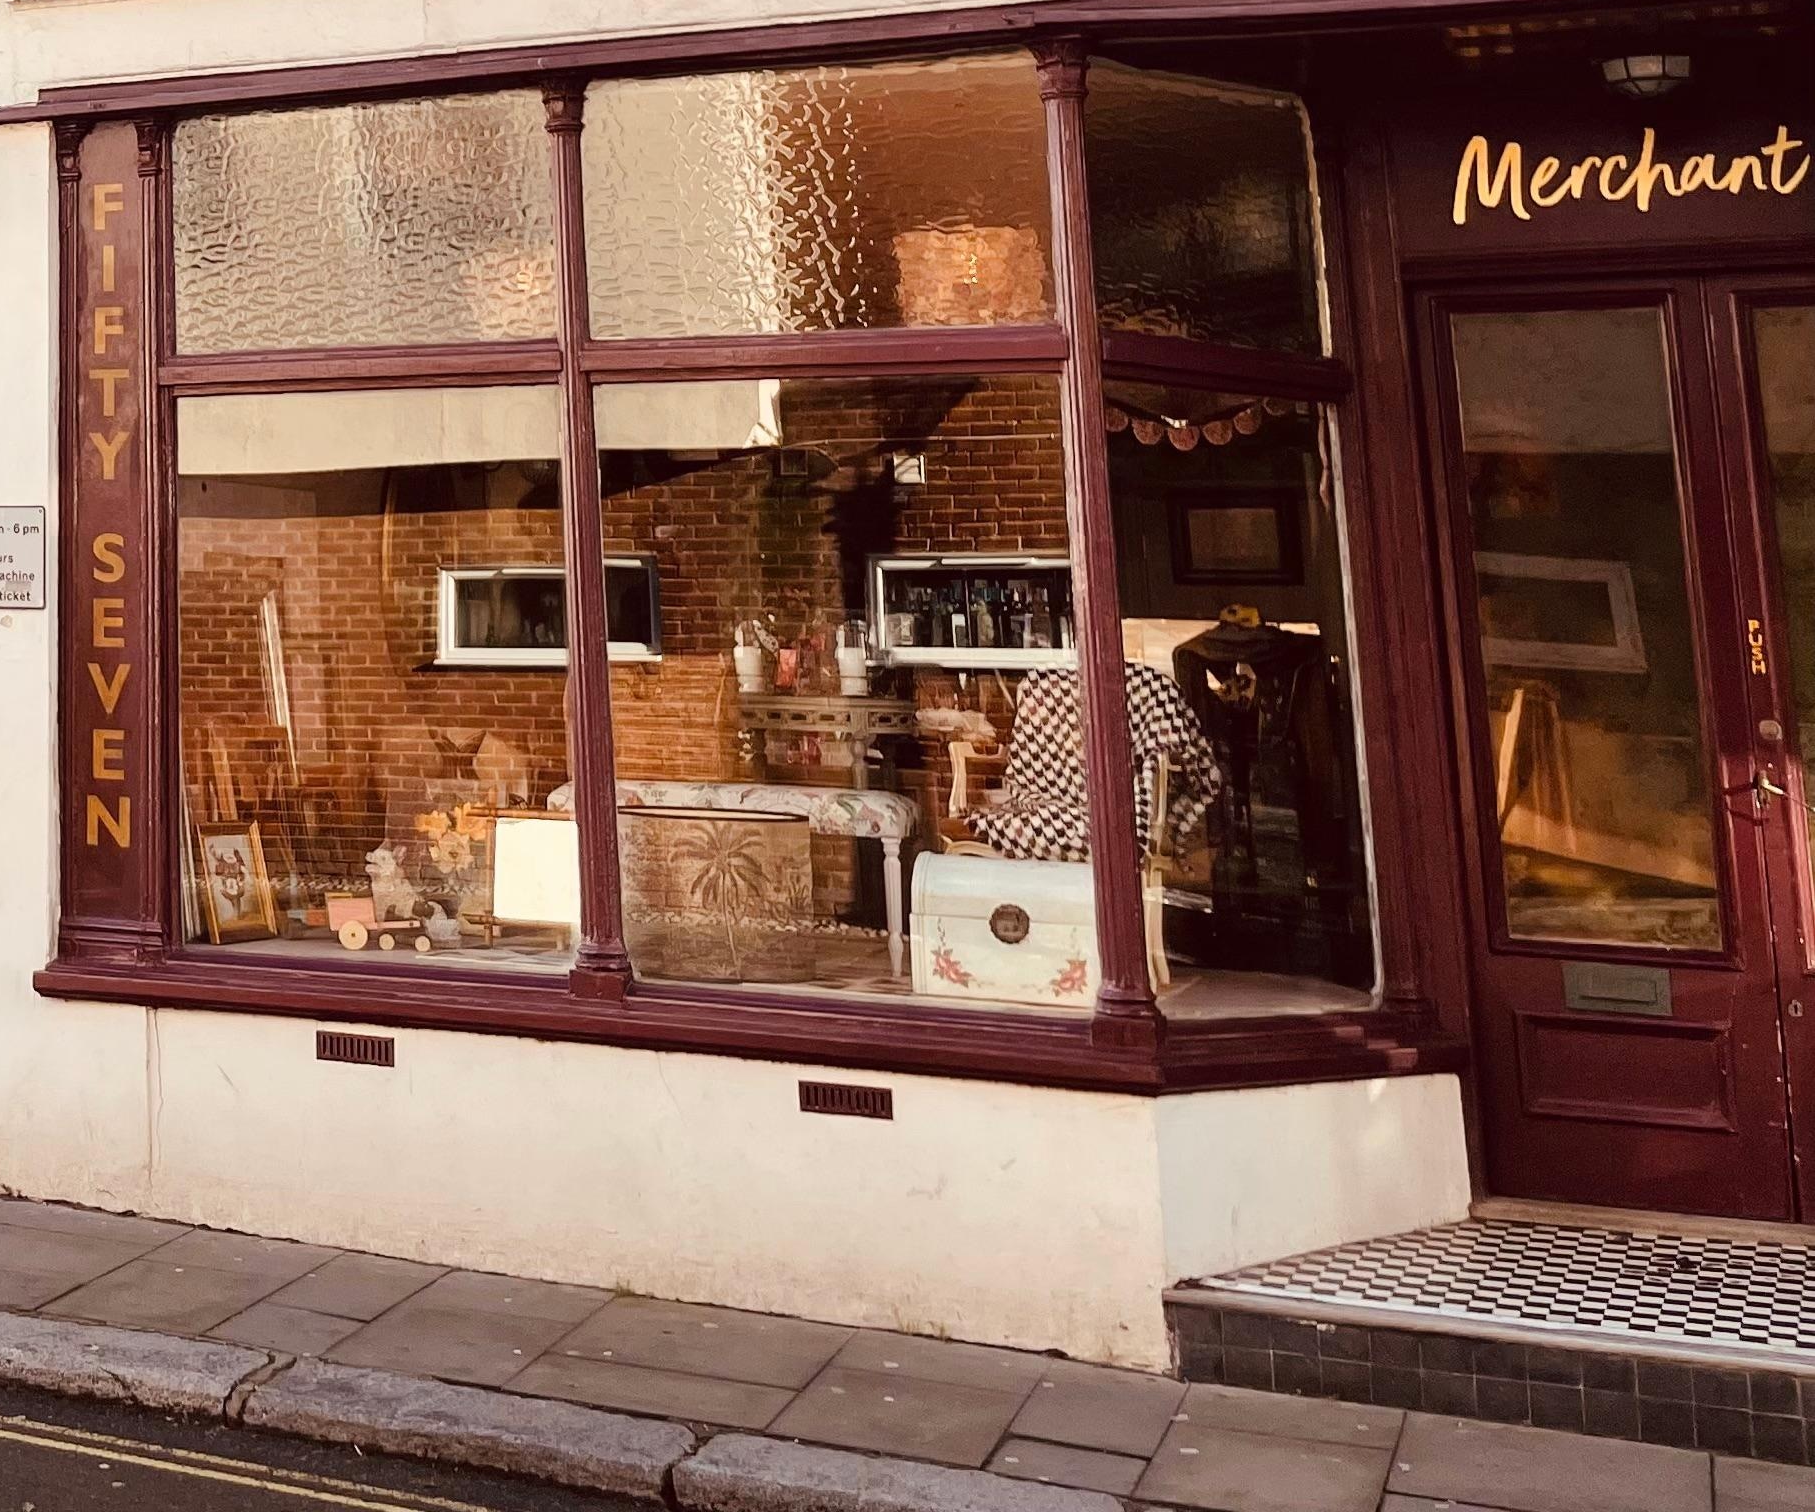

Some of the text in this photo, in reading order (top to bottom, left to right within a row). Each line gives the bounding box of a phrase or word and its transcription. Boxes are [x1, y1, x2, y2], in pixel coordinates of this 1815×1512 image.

[1452, 125, 1810, 225] Merchant
[87, 183, 131, 848] FIFTY SEVEN
[0, 591, 31, 601] ticket
[1748, 619, 1766, 675] PUSH
